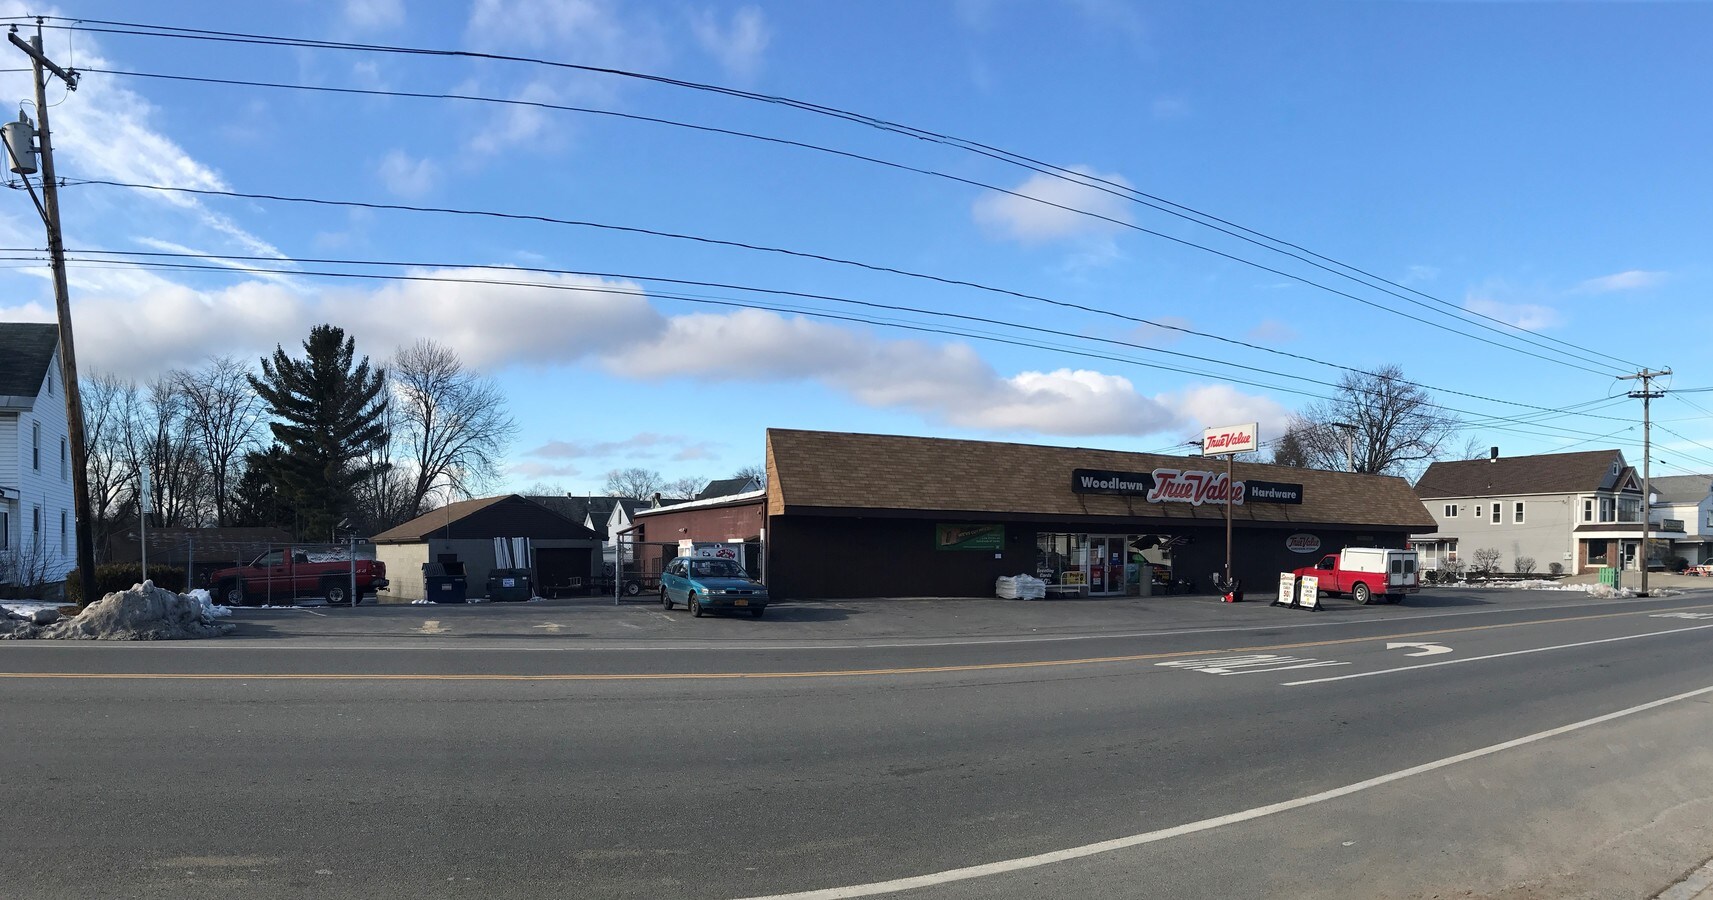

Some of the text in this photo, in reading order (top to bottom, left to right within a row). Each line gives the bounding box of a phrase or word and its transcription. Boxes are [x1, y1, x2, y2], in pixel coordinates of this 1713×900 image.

[1205, 431, 1251, 450] True Value
[1080, 475, 1144, 491] Woodlawn
[1152, 473, 1193, 499] True
[1251, 485, 1297, 500] Hardware
[1289, 537, 1319, 547] True Value
